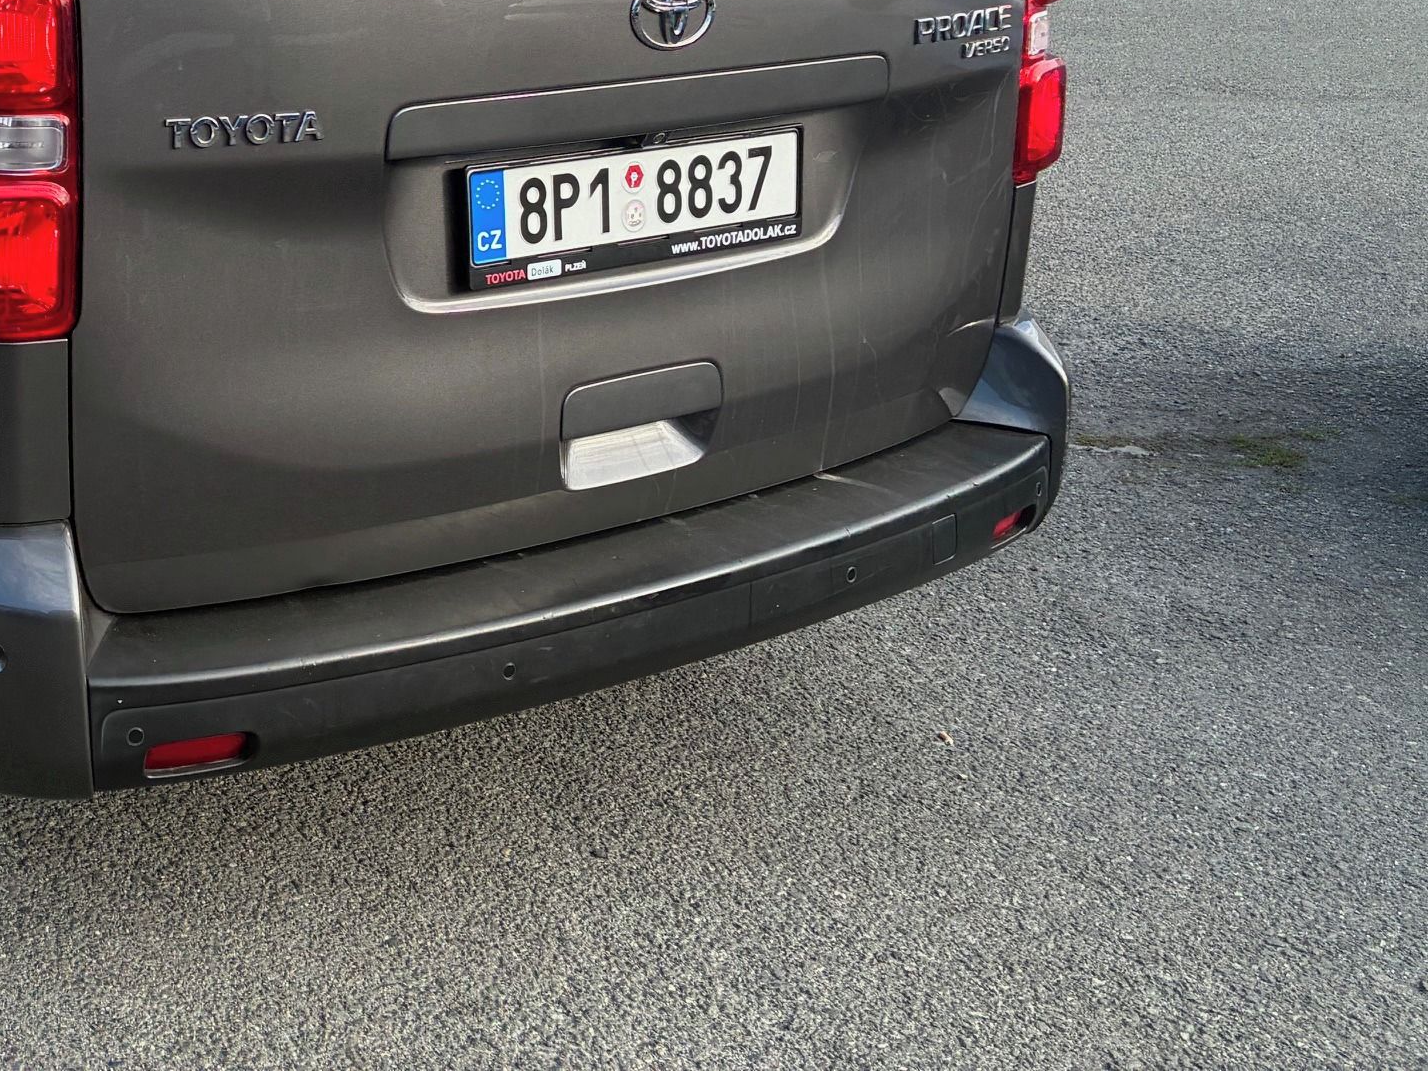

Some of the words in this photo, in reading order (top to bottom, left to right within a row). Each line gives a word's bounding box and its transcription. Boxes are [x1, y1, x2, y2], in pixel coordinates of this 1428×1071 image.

[914, 4, 1012, 45] PROACE
[960, 35, 1011, 59] VERSO
[164, 109, 324, 150] TOYOTA
[477, 228, 503, 252] CZ
[520, 167, 610, 244] 8P1
[656, 145, 773, 224] 8837
[671, 223, 797, 255] www.TOYOTADOLAK.cz
[485, 269, 527, 285] TOYOTA
[531, 266, 554, 277] Dolák
